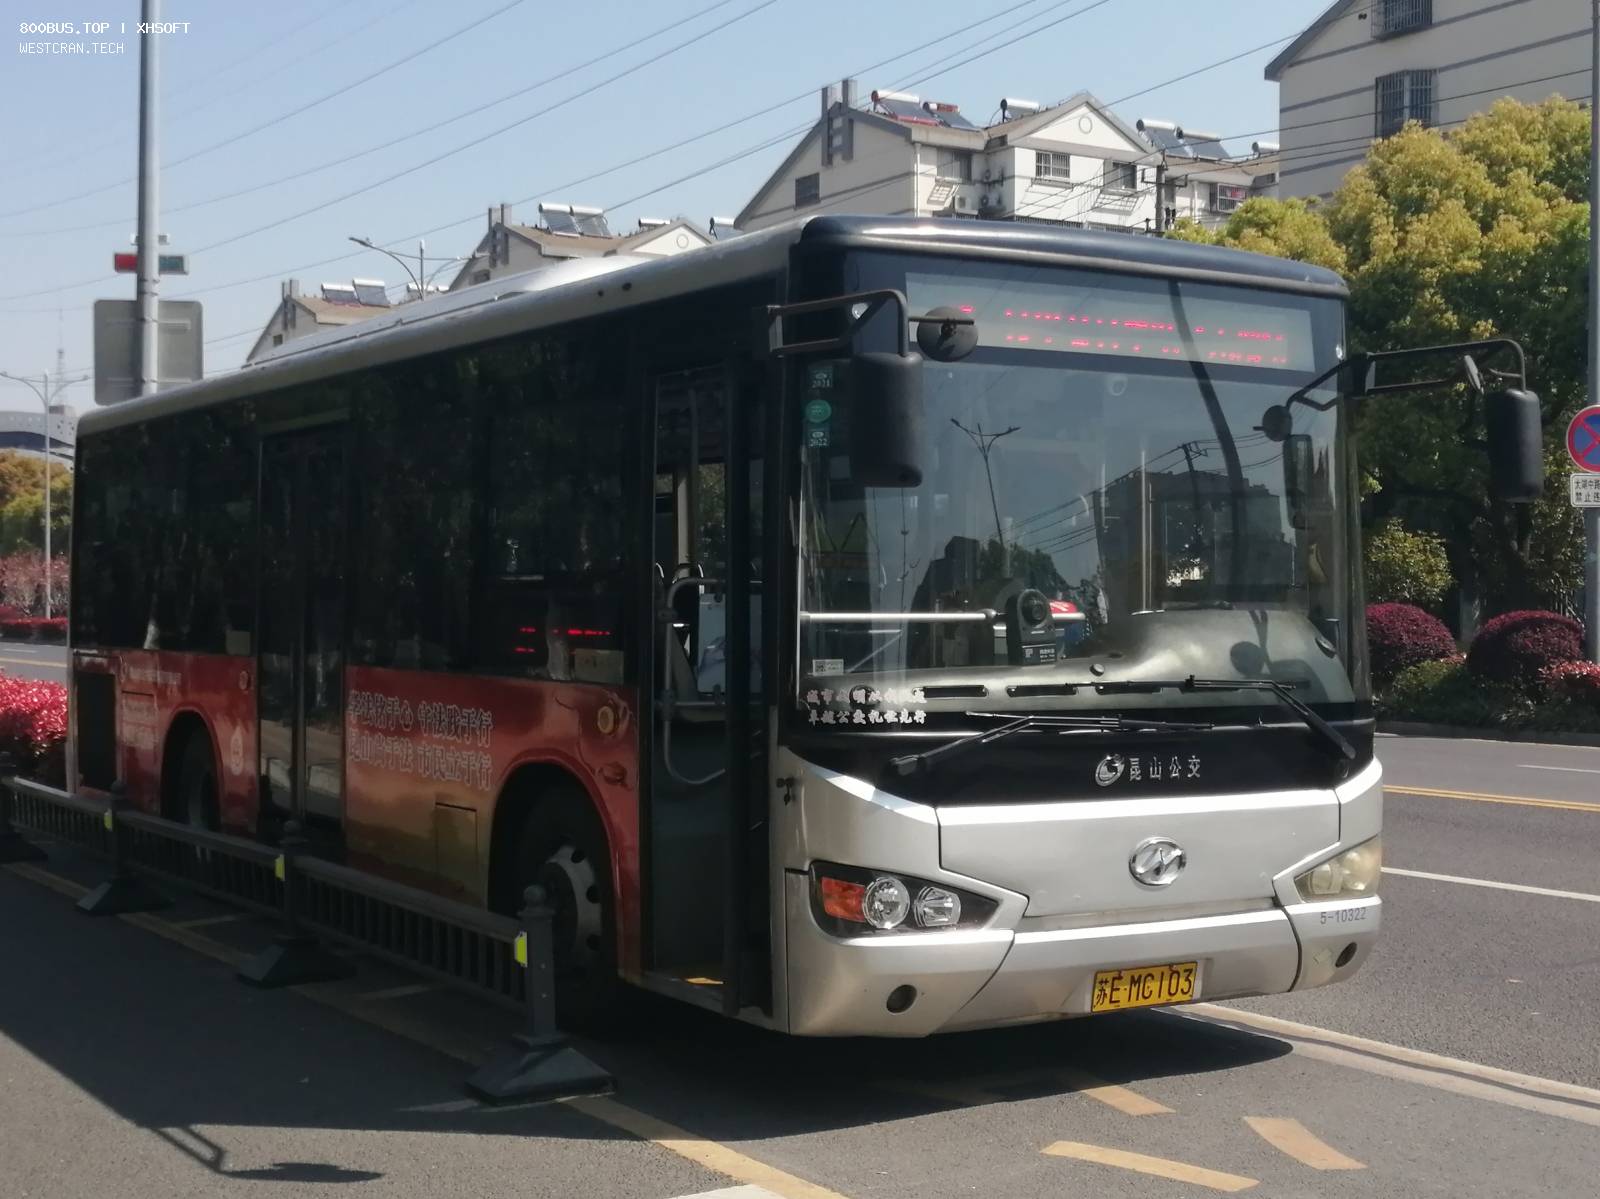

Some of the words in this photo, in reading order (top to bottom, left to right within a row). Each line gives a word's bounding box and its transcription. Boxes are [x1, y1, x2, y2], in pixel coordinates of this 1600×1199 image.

[1129, 755, 1200, 781] 昆山公交
[1320, 907, 1367, 925] 5-10322
